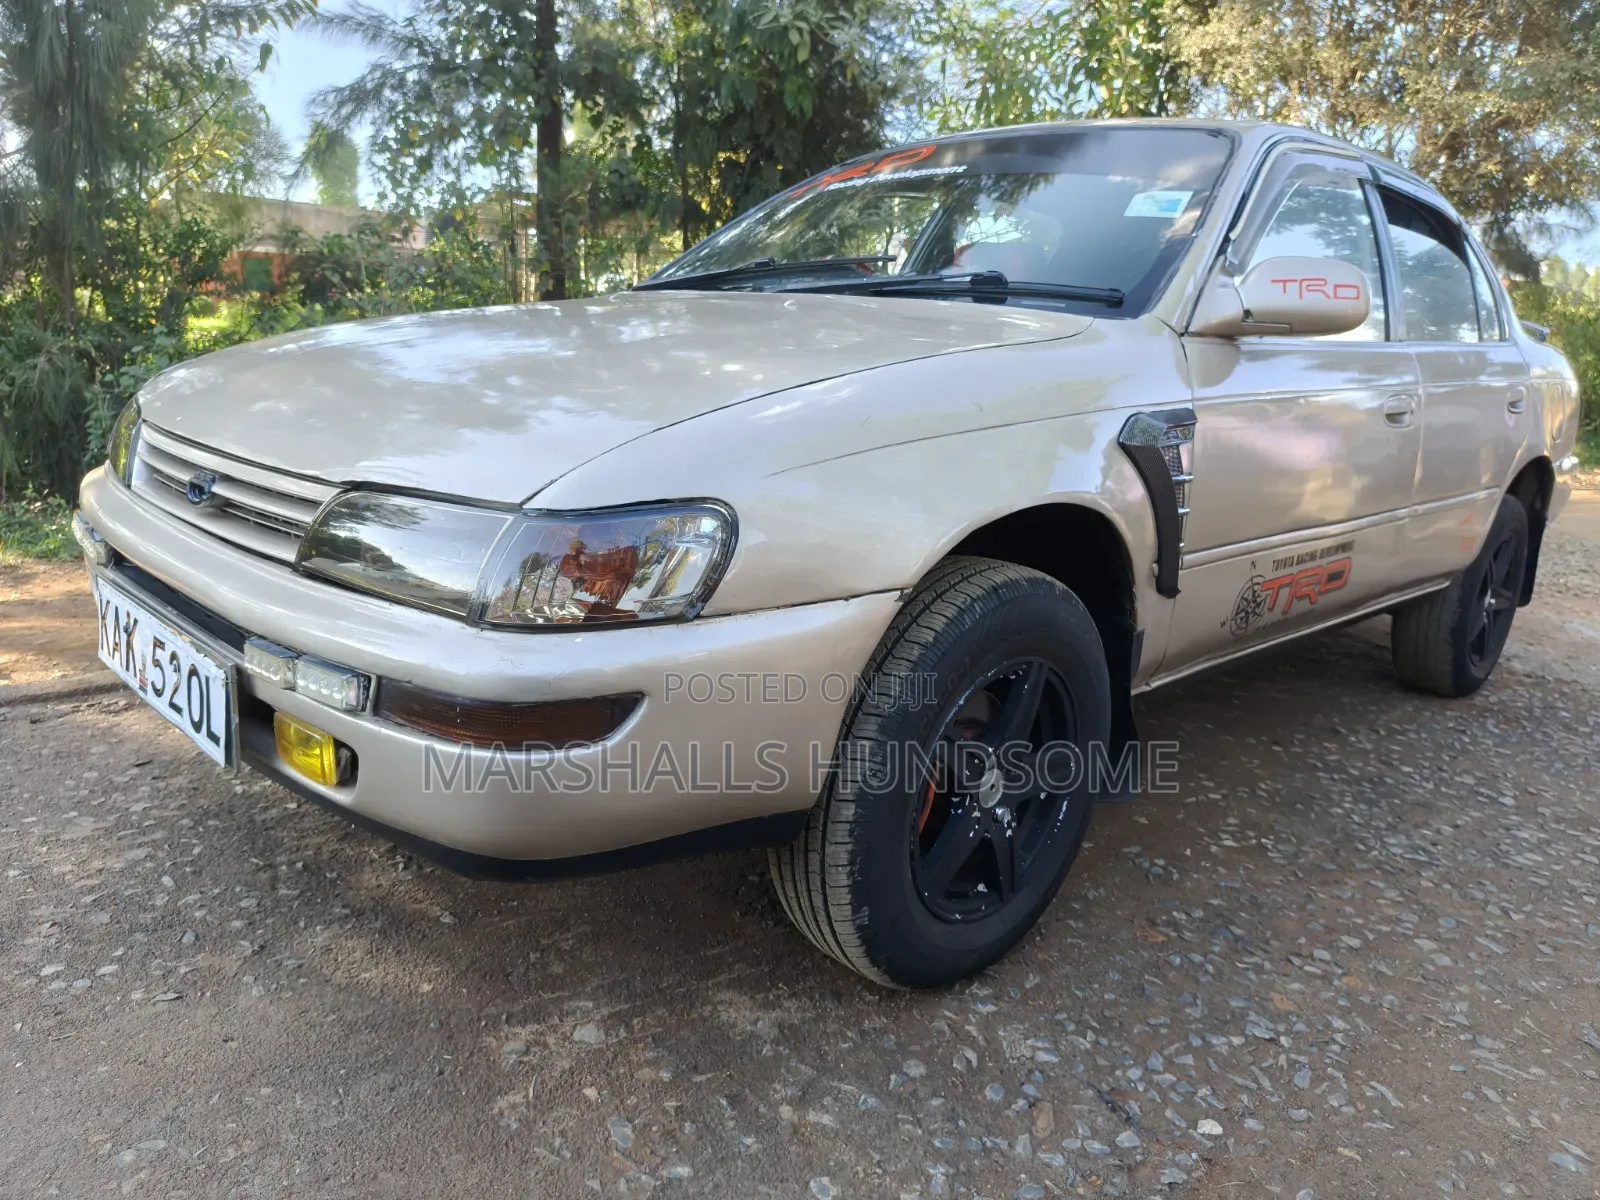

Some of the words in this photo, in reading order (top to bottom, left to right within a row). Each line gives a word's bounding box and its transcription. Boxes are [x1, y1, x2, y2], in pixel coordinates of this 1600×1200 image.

[1270, 278, 1360, 300] TRD
[1272, 555, 1295, 573] TOYOTA
[1295, 549, 1318, 566] RACING
[1260, 556, 1353, 616] TRD
[99, 598, 139, 679] KAK
[150, 635, 221, 748] 520L
